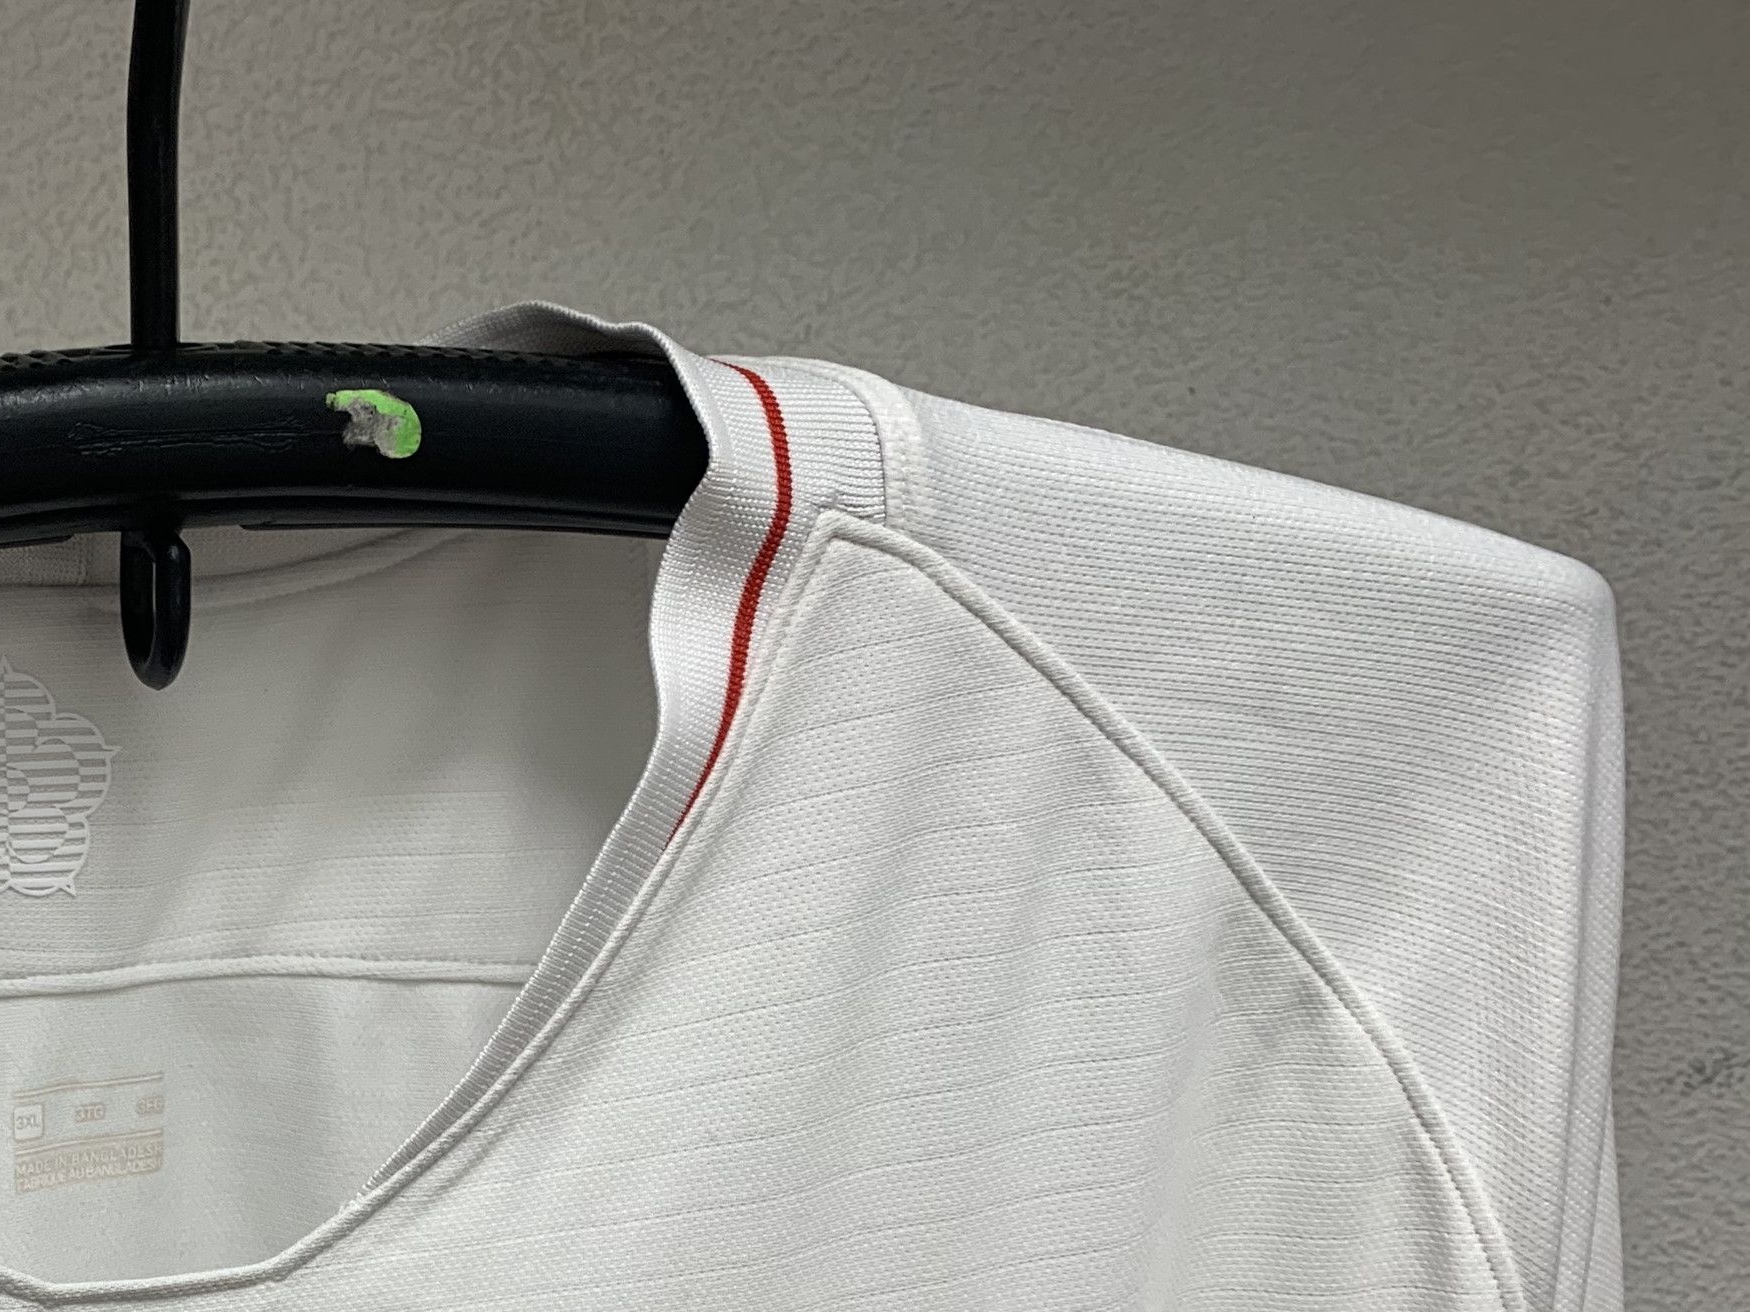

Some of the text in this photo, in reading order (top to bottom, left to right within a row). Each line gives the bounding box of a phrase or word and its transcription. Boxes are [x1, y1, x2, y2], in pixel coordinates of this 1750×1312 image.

[16, 1114, 41, 1130] 3XL
[16, 1158, 51, 1174] MADE
[54, 1155, 67, 1169] IN
